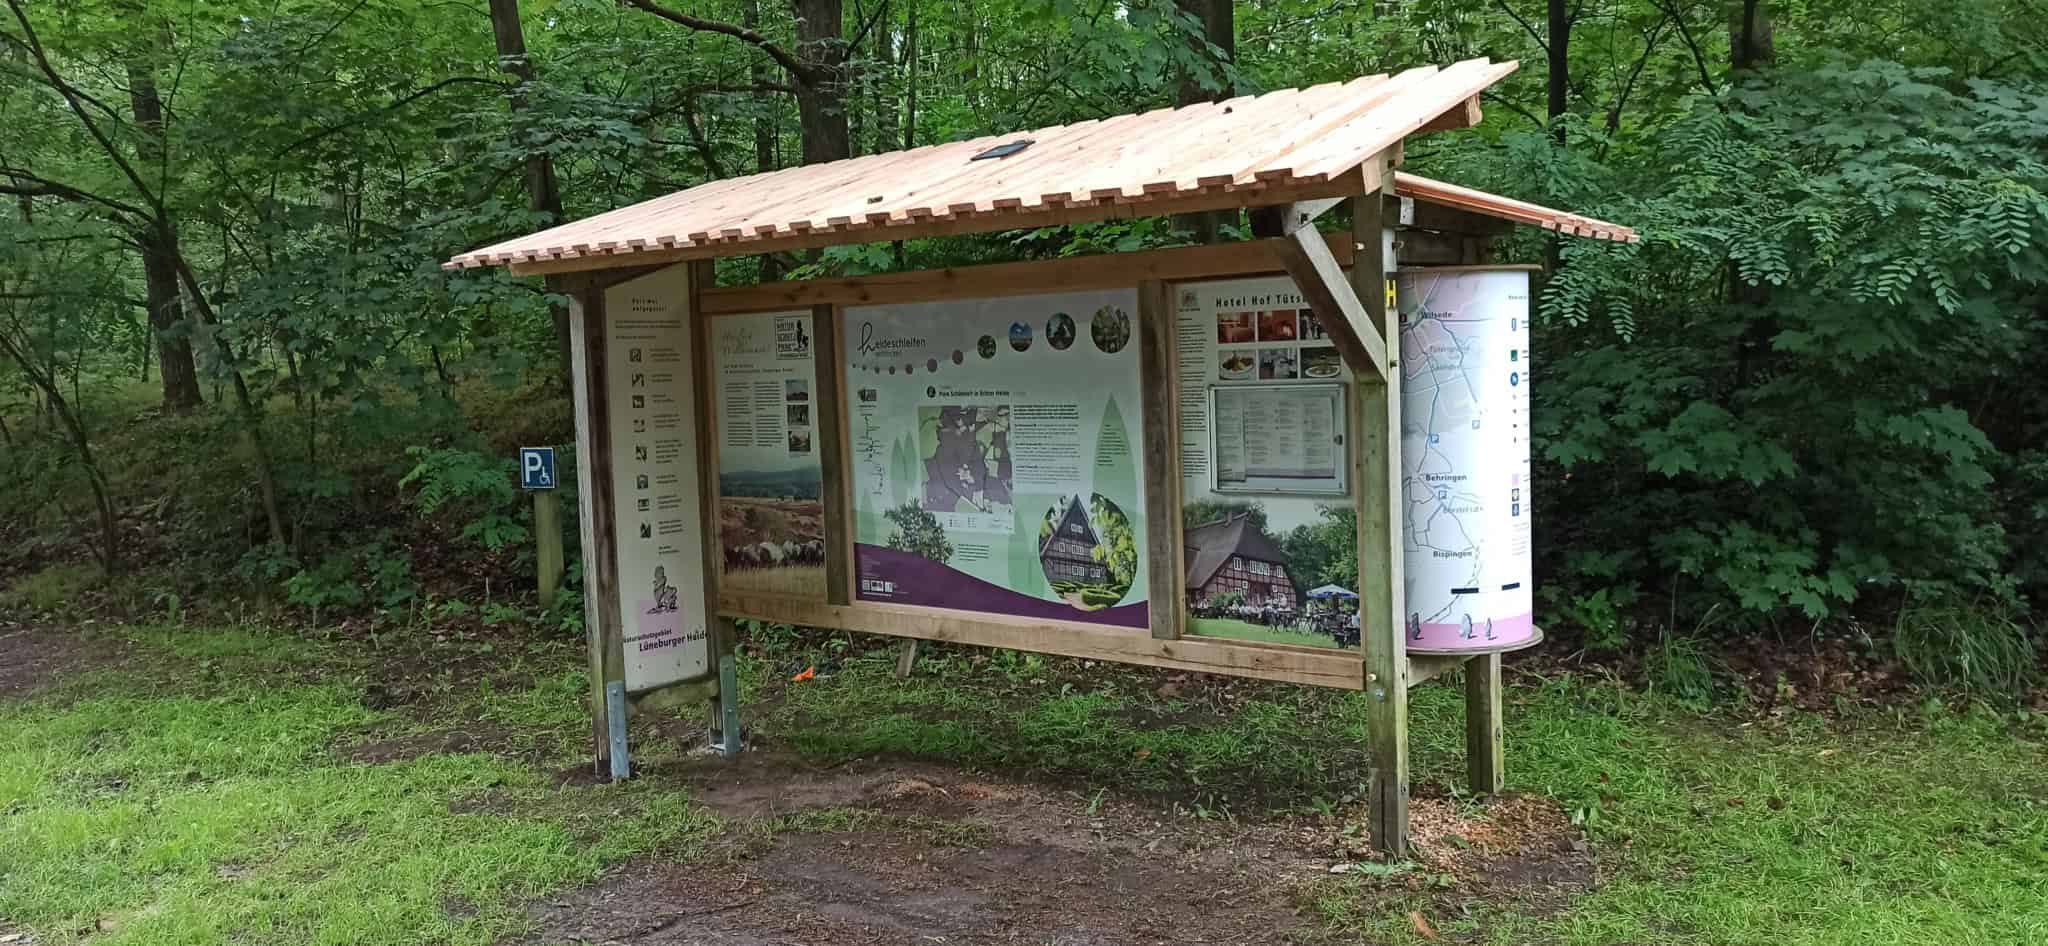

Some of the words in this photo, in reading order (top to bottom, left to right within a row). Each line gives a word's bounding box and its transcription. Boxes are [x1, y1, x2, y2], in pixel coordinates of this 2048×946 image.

[1216, 297, 1246, 308] Hotel
[1251, 295, 1270, 306] Hof
[524, 452, 542, 482] P
[1425, 474, 1467, 482] Behringen
[1433, 550, 1473, 559] Bispingen
[639, 636, 686, 652] Lüneburger
